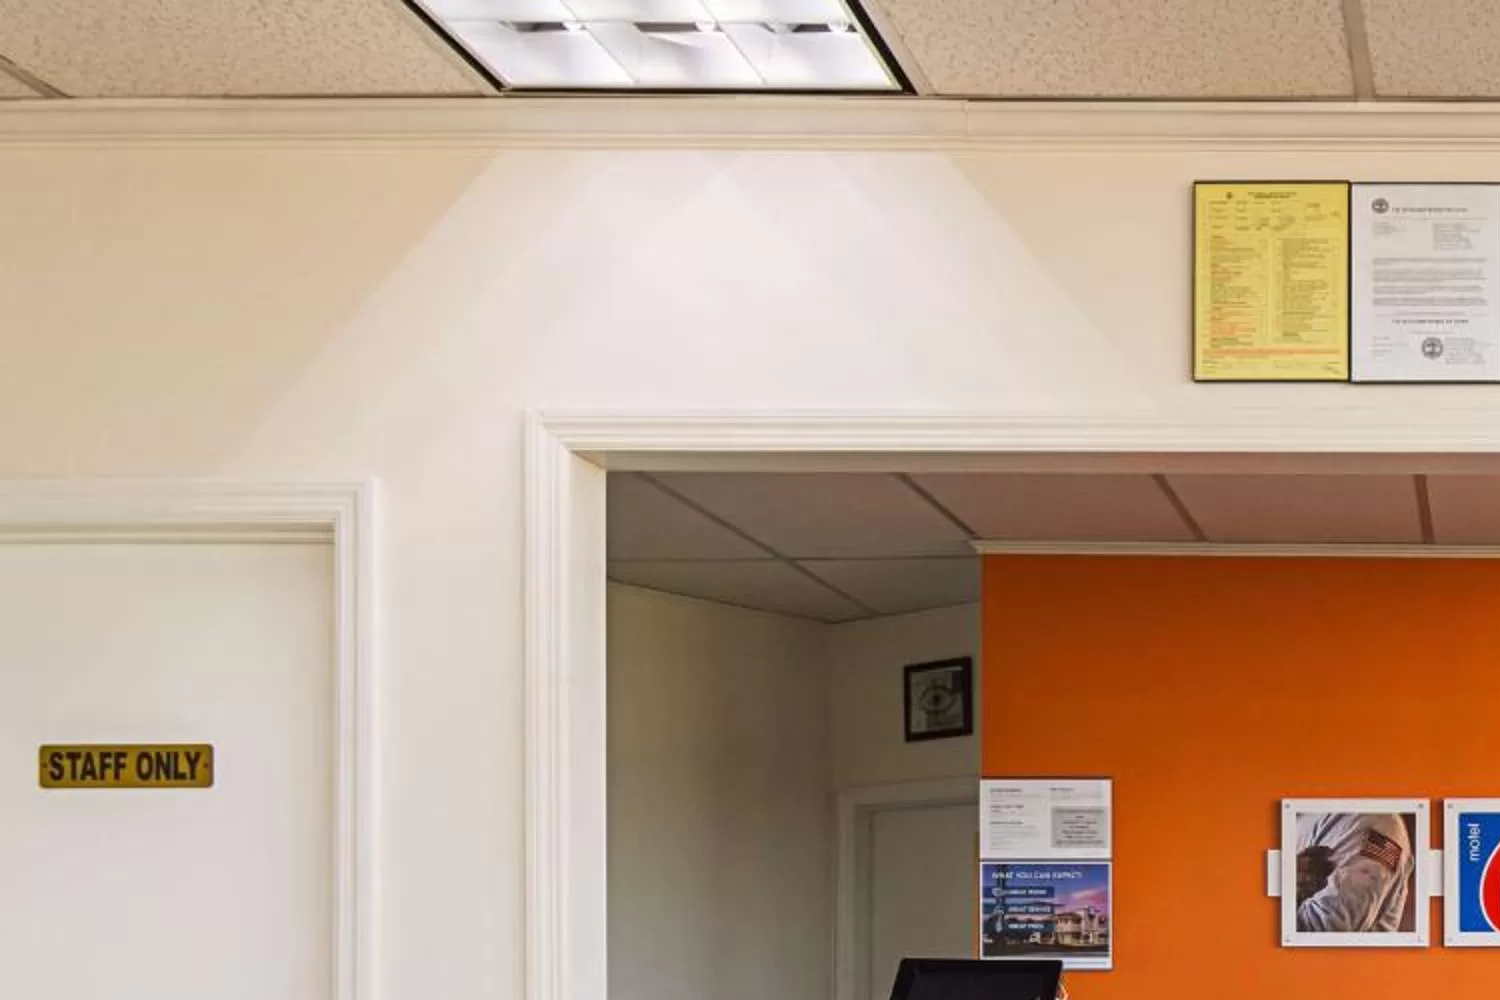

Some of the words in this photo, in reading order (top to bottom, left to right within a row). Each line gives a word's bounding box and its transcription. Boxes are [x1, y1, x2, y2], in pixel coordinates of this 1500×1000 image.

[48, 751, 128, 781] STAFF
[135, 751, 202, 781] ONLY
[1467, 823, 1480, 861] motel
